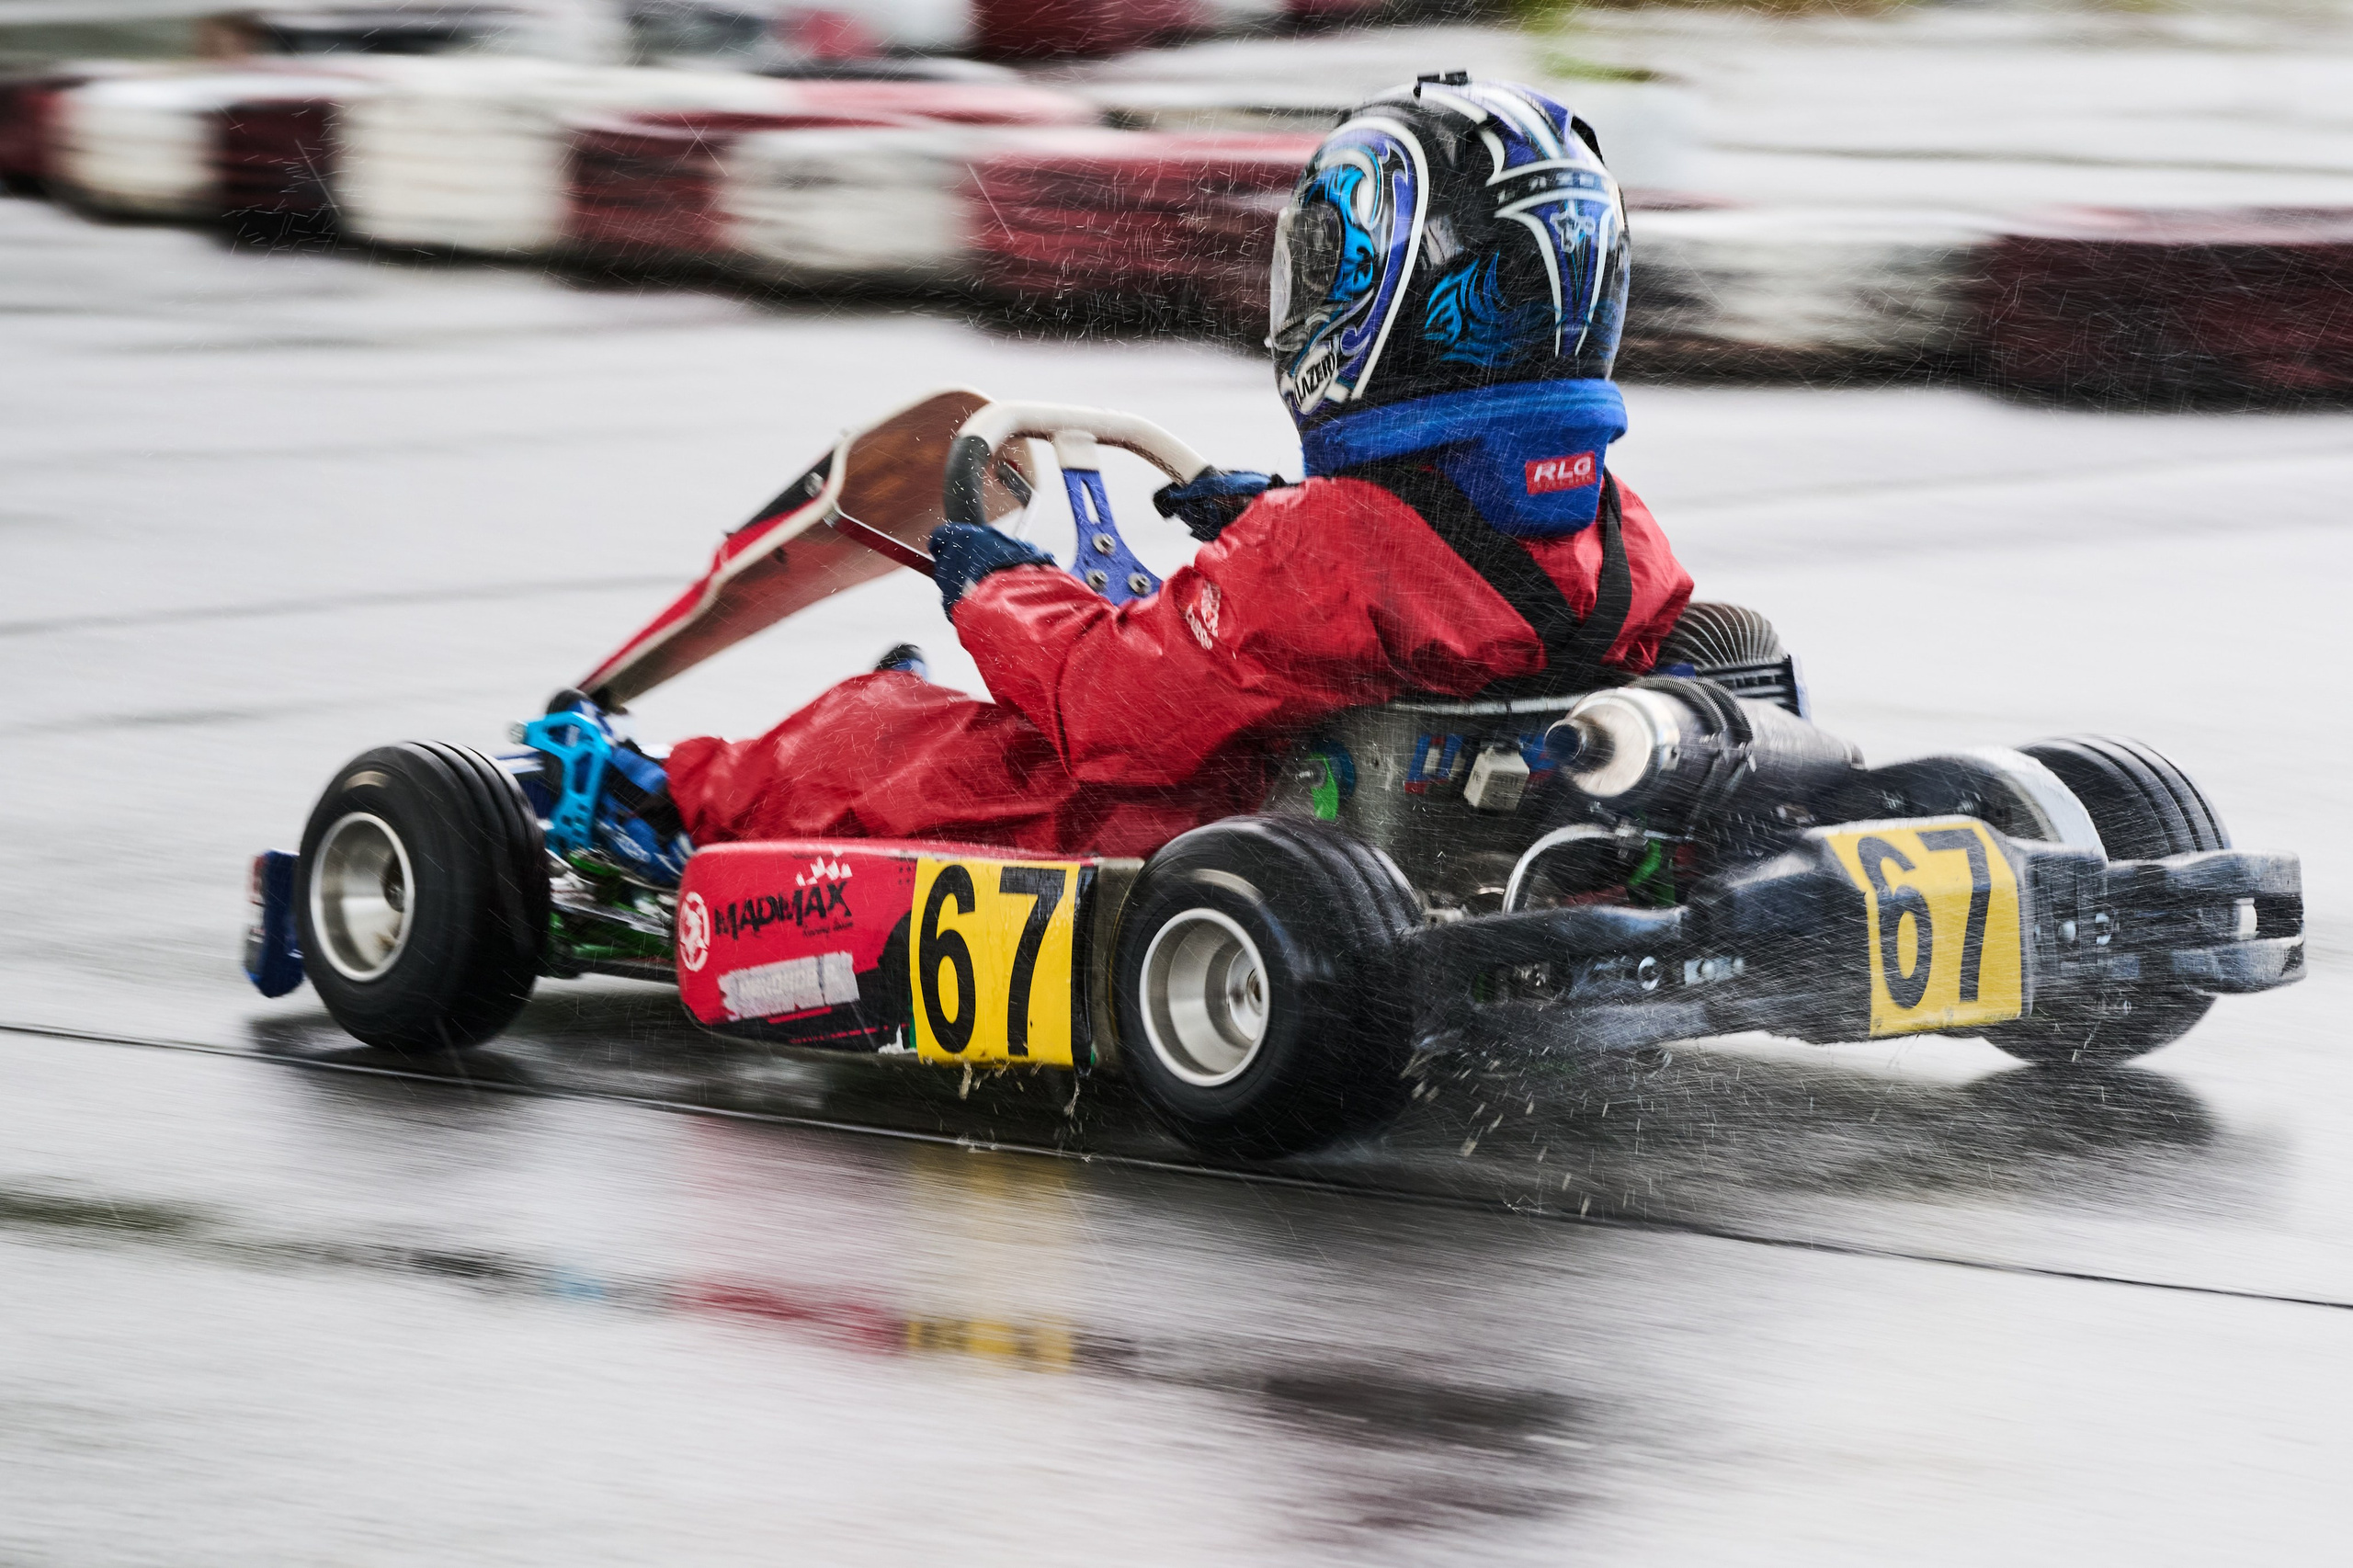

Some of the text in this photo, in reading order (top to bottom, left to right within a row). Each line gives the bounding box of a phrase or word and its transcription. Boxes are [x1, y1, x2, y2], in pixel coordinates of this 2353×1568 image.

[1533, 456, 1591, 483] RLG
[713, 881, 853, 940] MADMAX
[918, 864, 1066, 1056] 67
[1858, 829, 1991, 1008] 67
